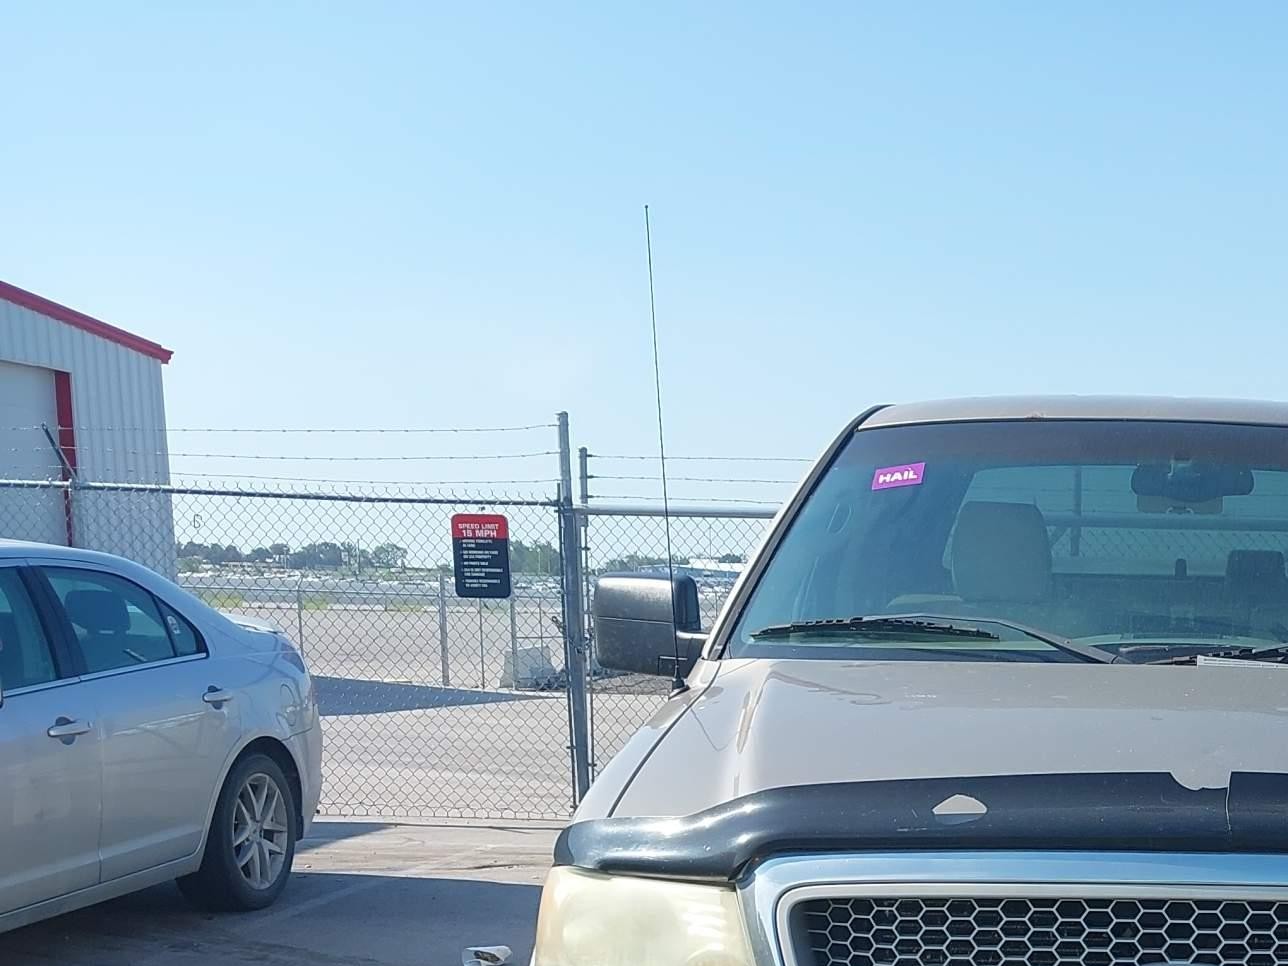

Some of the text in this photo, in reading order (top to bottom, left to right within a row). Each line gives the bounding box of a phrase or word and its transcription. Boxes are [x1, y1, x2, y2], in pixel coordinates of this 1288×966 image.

[878, 469, 918, 484] HAIL
[462, 529, 497, 538] 15 MPH
